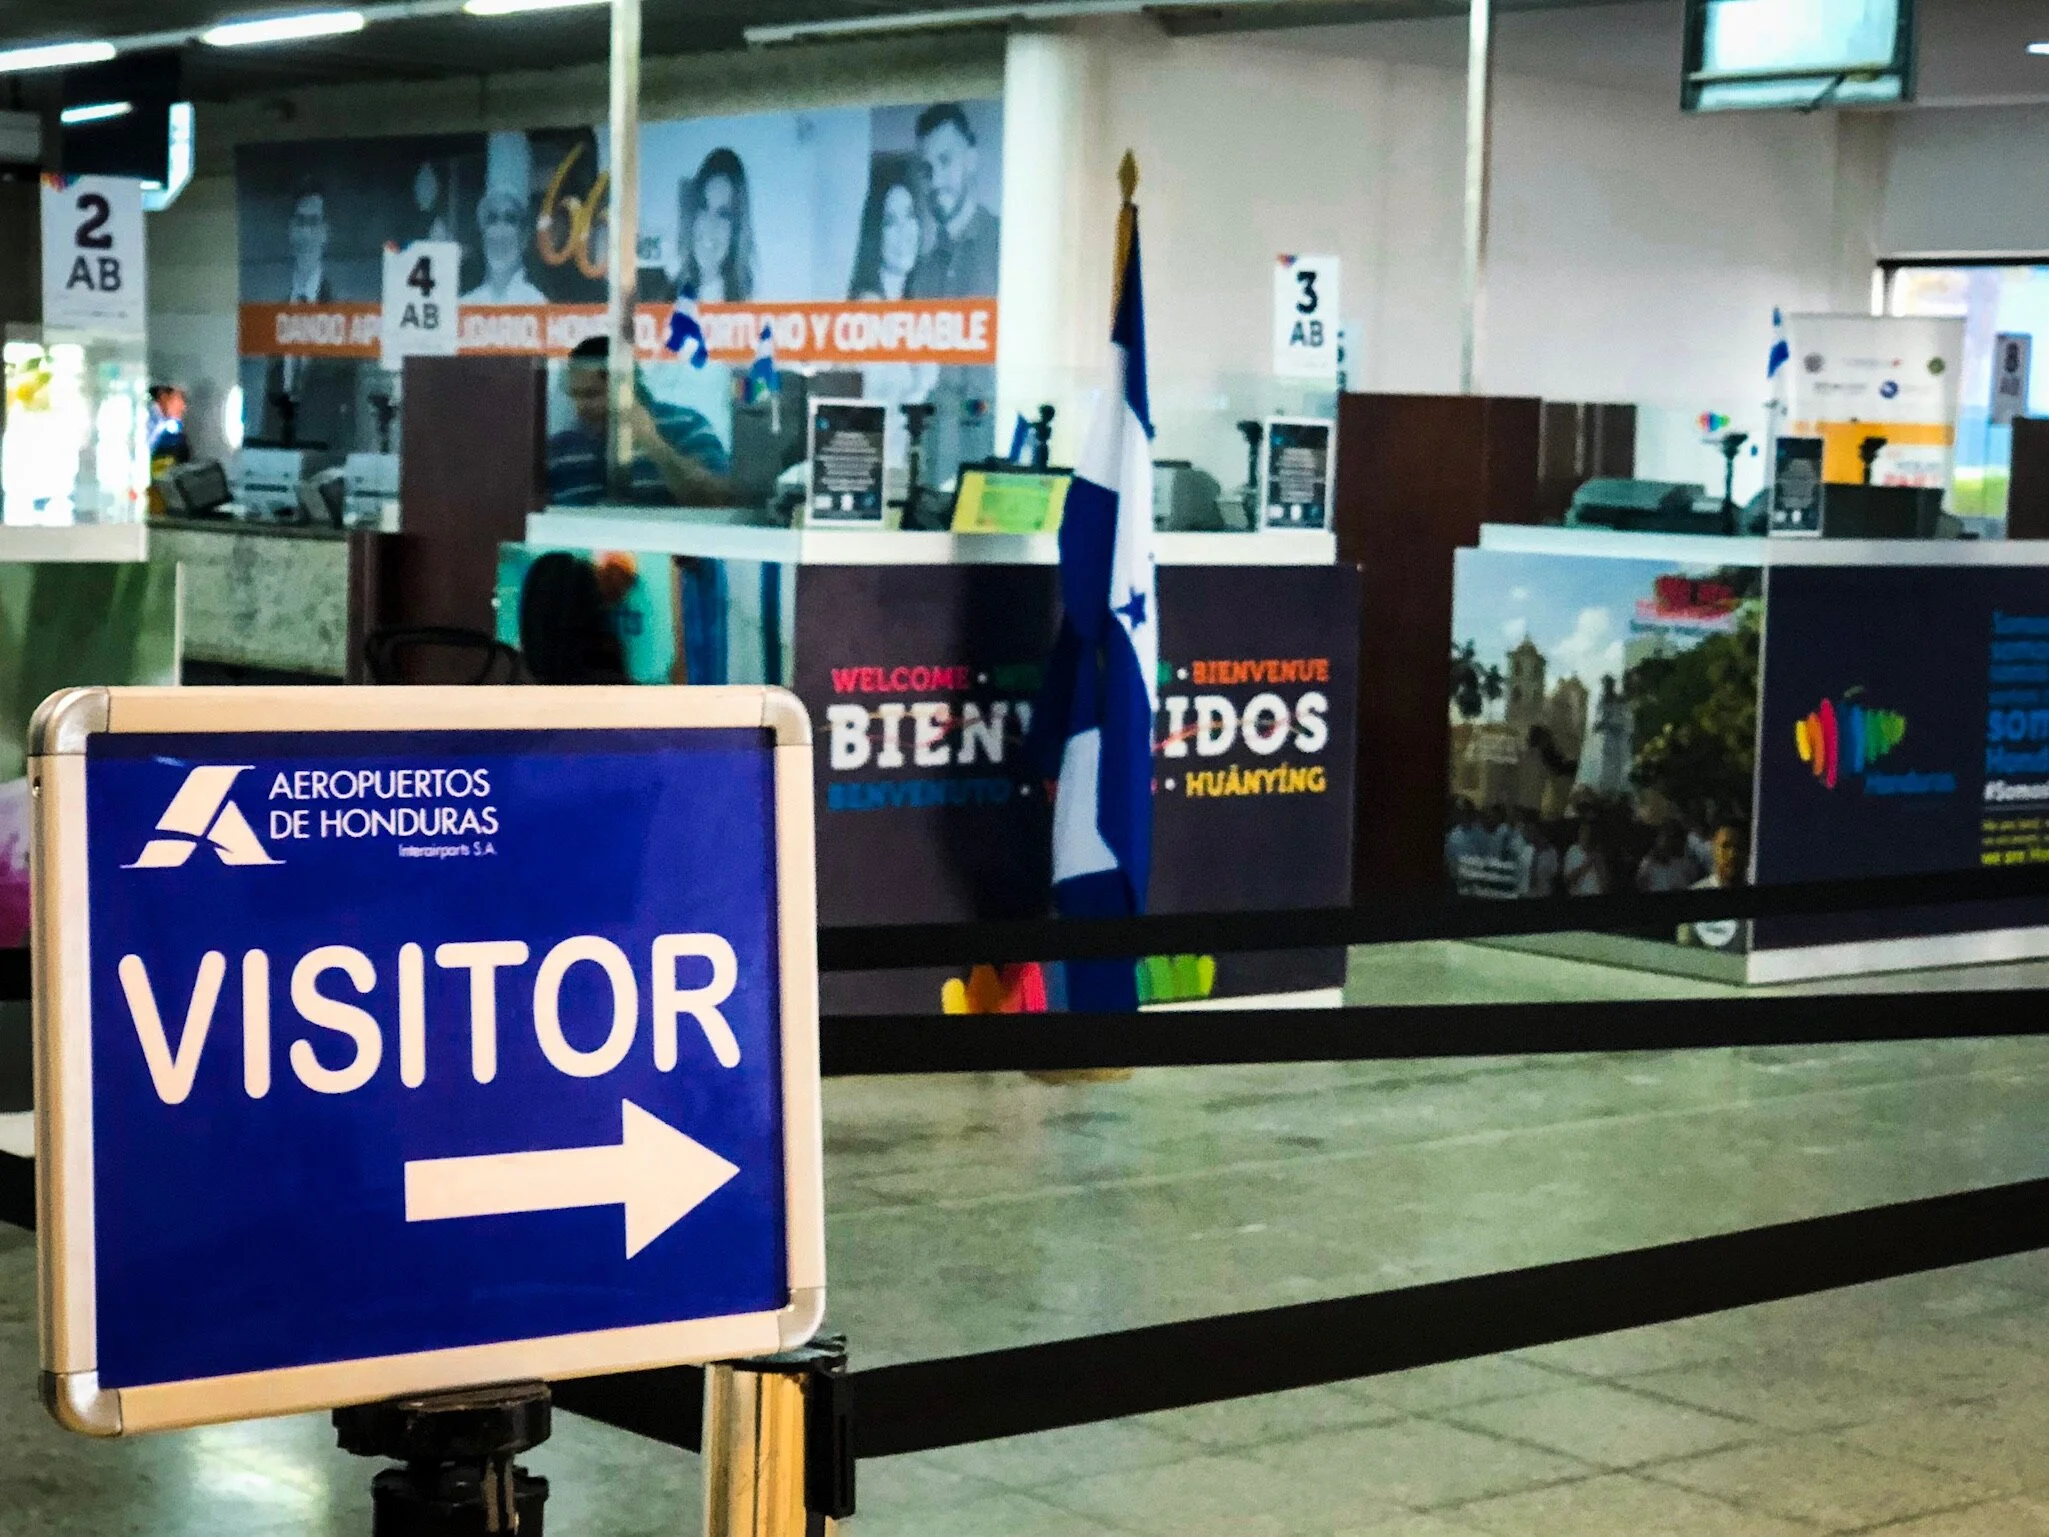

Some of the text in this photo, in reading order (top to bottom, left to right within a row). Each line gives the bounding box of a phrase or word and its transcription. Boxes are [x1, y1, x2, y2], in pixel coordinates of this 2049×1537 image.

[75, 193, 113, 250] 2
[66, 254, 122, 292] AB
[407, 255, 436, 297] 4
[1296, 270, 1318, 314] 3
[400, 303, 440, 329] AB
[809, 312, 834, 350] Y
[834, 310, 989, 351] CONFIABLE
[1289, 319, 1324, 347] AB
[831, 666, 970, 694] WELCOME
[1192, 657, 1330, 685] BIENVENUE
[826, 690, 1329, 770] BIENIDOS
[267, 767, 491, 801] AEROPUERTOS
[269, 806, 500, 840] DE HONDURAS
[118, 932, 742, 1106] VISITOR
